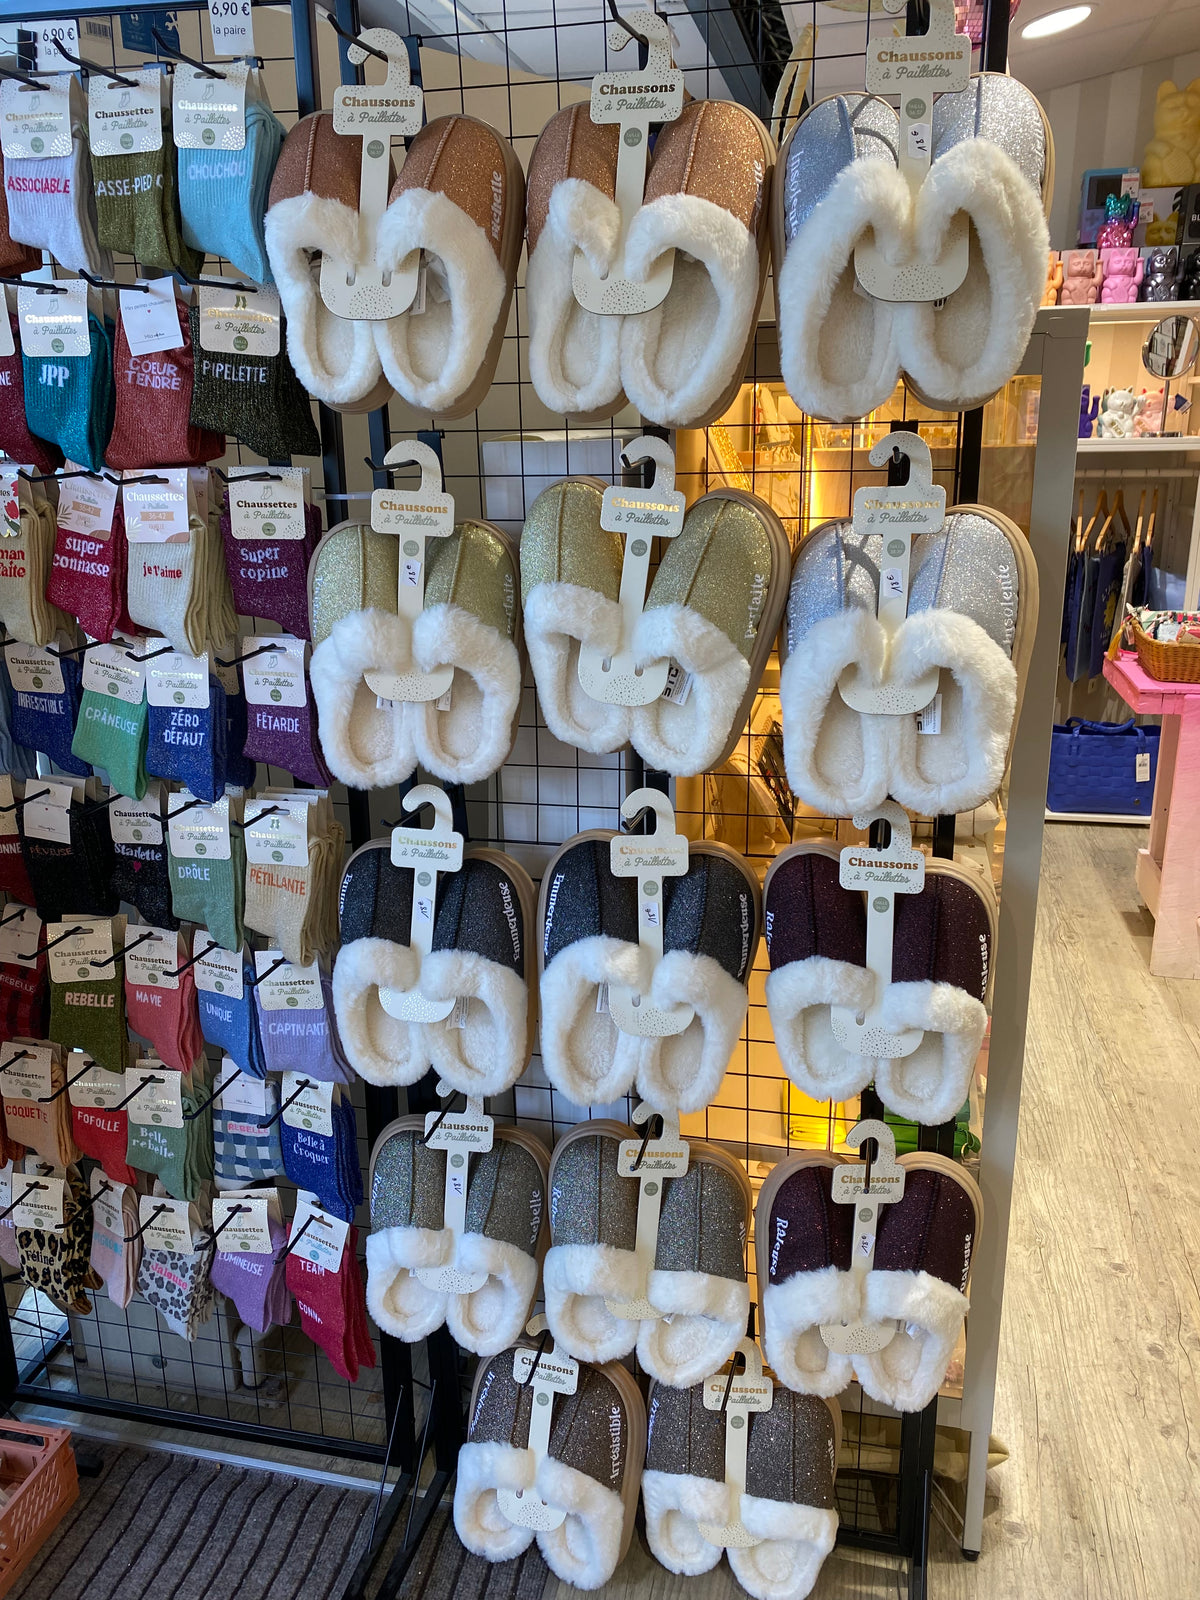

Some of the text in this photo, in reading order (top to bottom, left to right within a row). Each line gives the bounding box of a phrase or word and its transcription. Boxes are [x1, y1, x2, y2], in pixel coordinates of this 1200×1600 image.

[212, 1, 251, 17] 6,90 €
[67, 26, 75, 41] €
[213, 25, 247, 37] la paire
[45, 46, 73, 58] la pre
[876, 50, 964, 63] Chaussons
[895, 65, 953, 80] Paillettes
[599, 83, 676, 96] Chaussons
[178, 100, 239, 112] Chaussettes
[341, 95, 416, 108] Chaussons
[616, 97, 667, 111] Paillettes
[95, 107, 154, 119] Chaussettes
[358, 110, 408, 123] Paillettes
[7, 176, 70, 195] ASSOCIABLE
[95, 174, 152, 197] ASSE-PIED
[225, 322, 266, 334] Paillettes
[128, 358, 178, 377] COEUR
[203, 360, 267, 383] PIPELETTE
[38, 364, 70, 388] JPP
[124, 370, 181, 391] TENDRE
[126, 491, 185, 502] Chaussettes
[236, 500, 298, 509] Chaussettes
[379, 500, 449, 514] Chaussons
[611, 497, 680, 512] Chaussons
[253, 509, 292, 520] Paillettes
[394, 513, 441, 527] Paillettes
[625, 511, 671, 526] Paillettes
[879, 511, 931, 524] Paillettes
[65, 537, 104, 558] super
[240, 547, 280, 563] Super
[53, 554, 110, 577] connasse
[240, 564, 289, 582] copine
[10, 657, 55, 666] Chaussettes
[85, 707, 138, 735] CRÂNEUSE
[170, 709, 200, 727] ZÉRO
[256, 711, 300, 733] FÊTARDE
[163, 727, 206, 746] DÉFAUT
[398, 835, 458, 849] Chaussons
[114, 843, 163, 861] Starlette
[410, 848, 450, 860] Paillettes
[633, 856, 677, 867] Paillettes
[848, 857, 919, 871] Chaussons
[178, 863, 210, 881] DRÔLE
[864, 870, 911, 883] Paillettes
[250, 867, 306, 895] PÉTILLANTE
[54, 948, 107, 958] Chaussettes
[129, 954, 173, 965] Chaussettes
[65, 991, 115, 1008] REBELLE
[136, 990, 163, 1008] MA VIE
[206, 1002, 233, 1022] UNIQUE
[3, 1069, 45, 1080] Chaussettes
[6, 1105, 48, 1124] COQUETTE
[77, 1110, 121, 1132] FOFOLLE
[140, 1127, 168, 1146] Belle
[297, 1132, 319, 1149] Belle
[444, 1132, 482, 1143] Paillettes
[132, 1138, 175, 1159] rebelle
[293, 1143, 330, 1164] Croquer
[25, 1249, 55, 1266] Féline
[218, 1251, 264, 1276] LUMINEUSE
[299, 1260, 325, 1277] TEAM
[151, 1263, 188, 1290] Jalouse
[710, 1383, 768, 1395] Chussons
